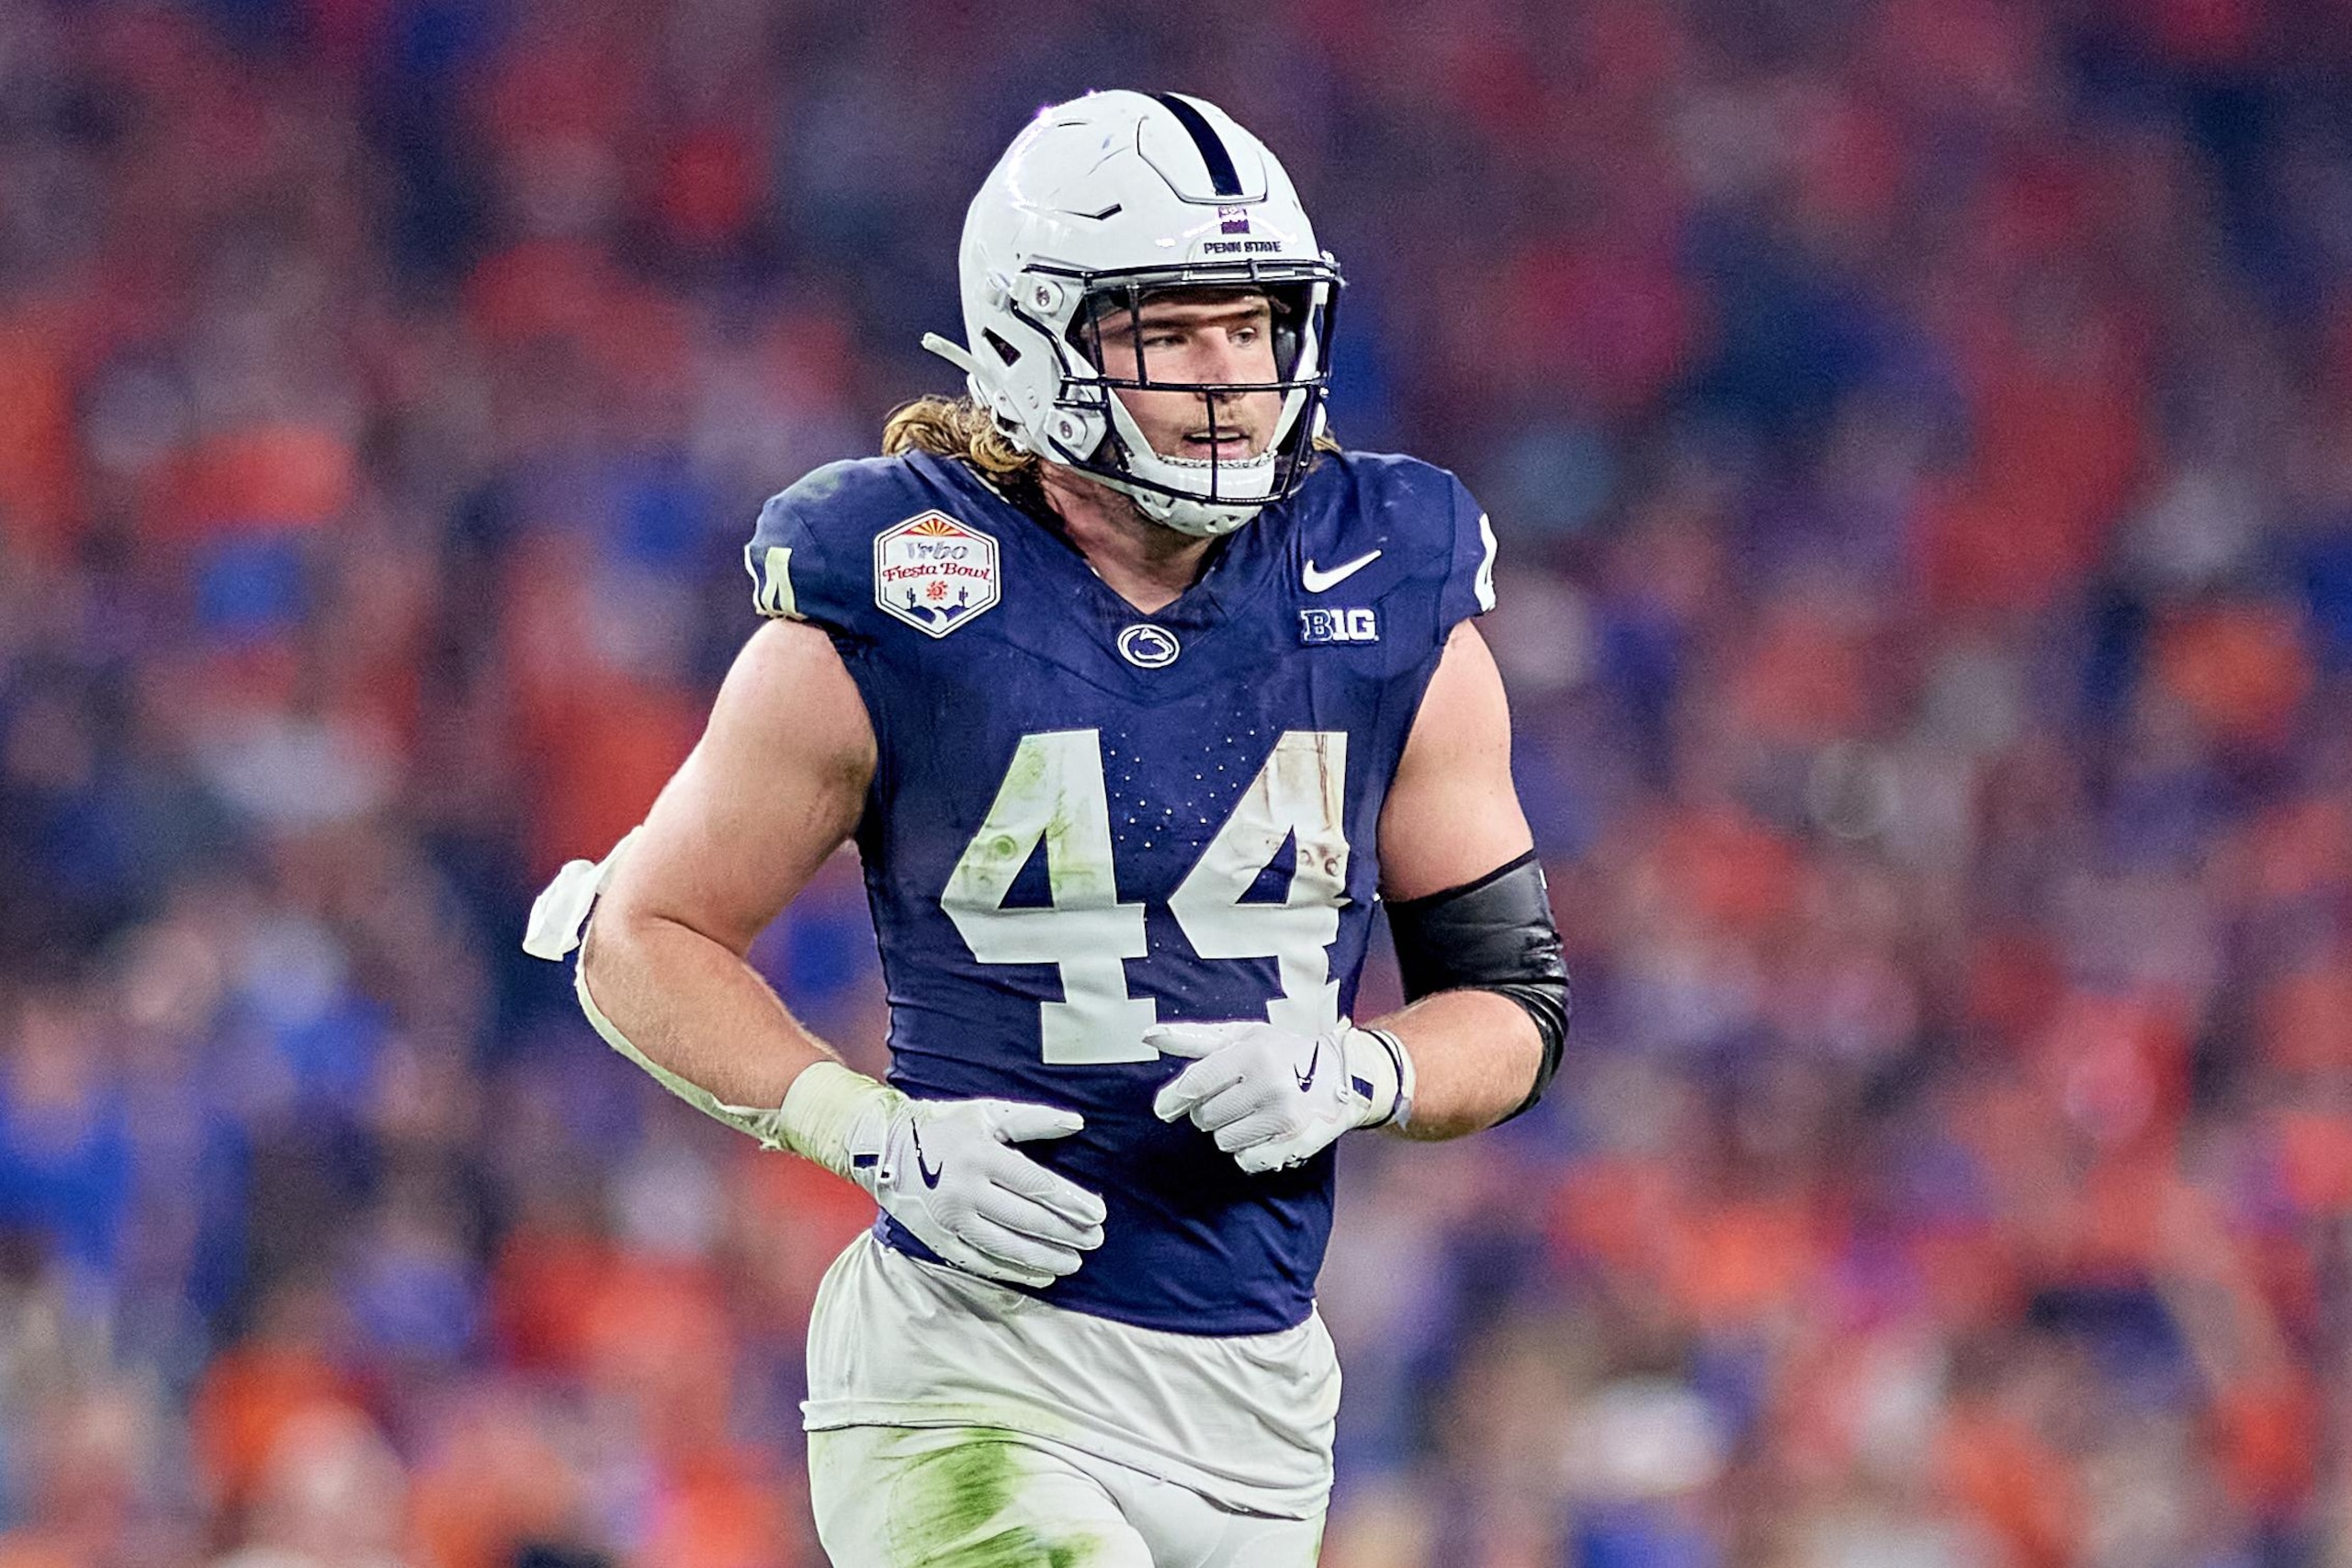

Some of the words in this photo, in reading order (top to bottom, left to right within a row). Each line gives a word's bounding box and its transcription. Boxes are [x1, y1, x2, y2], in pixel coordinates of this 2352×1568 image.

[1204, 242, 1241, 254] PENN
[1243, 241, 1283, 253] STATE
[883, 564, 937, 582] Fiesta
[940, 562, 991, 581] Bowl
[941, 728, 1350, 1065] 44
